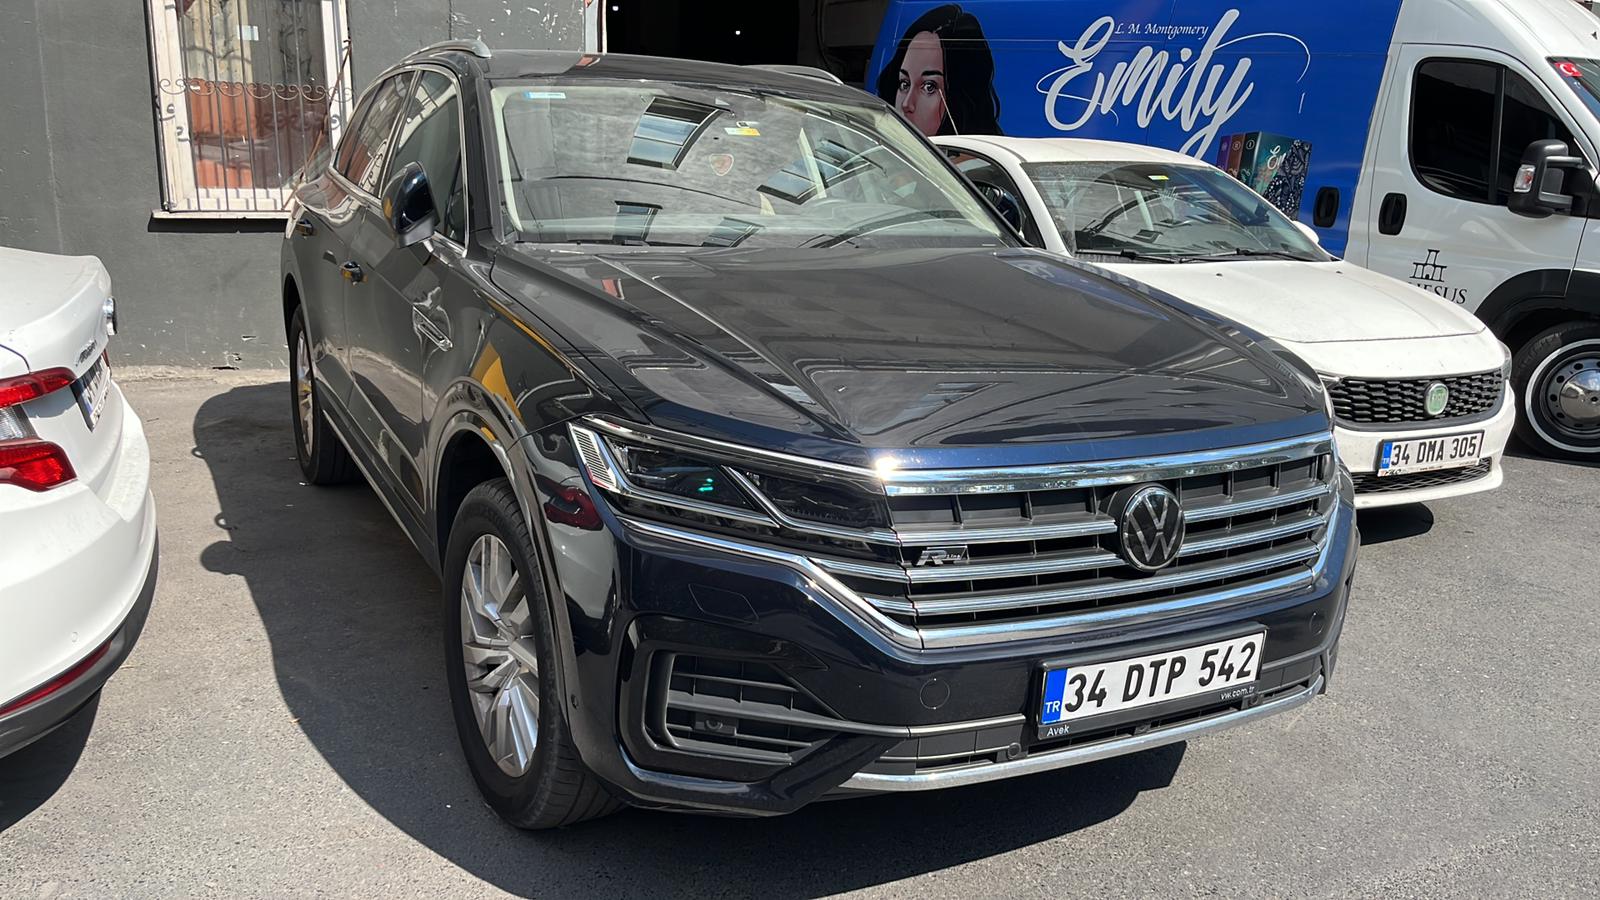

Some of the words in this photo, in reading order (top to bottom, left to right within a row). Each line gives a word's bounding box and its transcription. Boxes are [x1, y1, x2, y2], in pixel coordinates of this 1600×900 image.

[1114, 23, 1125, 34] L.
[1128, 23, 1141, 34] M.
[1144, 23, 1209, 40] Montgomery
[1036, 8, 1254, 160] Emily
[1391, 443, 1410, 466] 34
[1416, 439, 1445, 463] DMA
[1450, 435, 1478, 459] 305
[1045, 699, 1060, 713] TR
[1064, 669, 1108, 713] 34
[1122, 655, 1187, 703] DTP
[1198, 641, 1257, 687] 542
[1219, 686, 1256, 700] vw.com.tr
[1046, 724, 1070, 737] Avek
